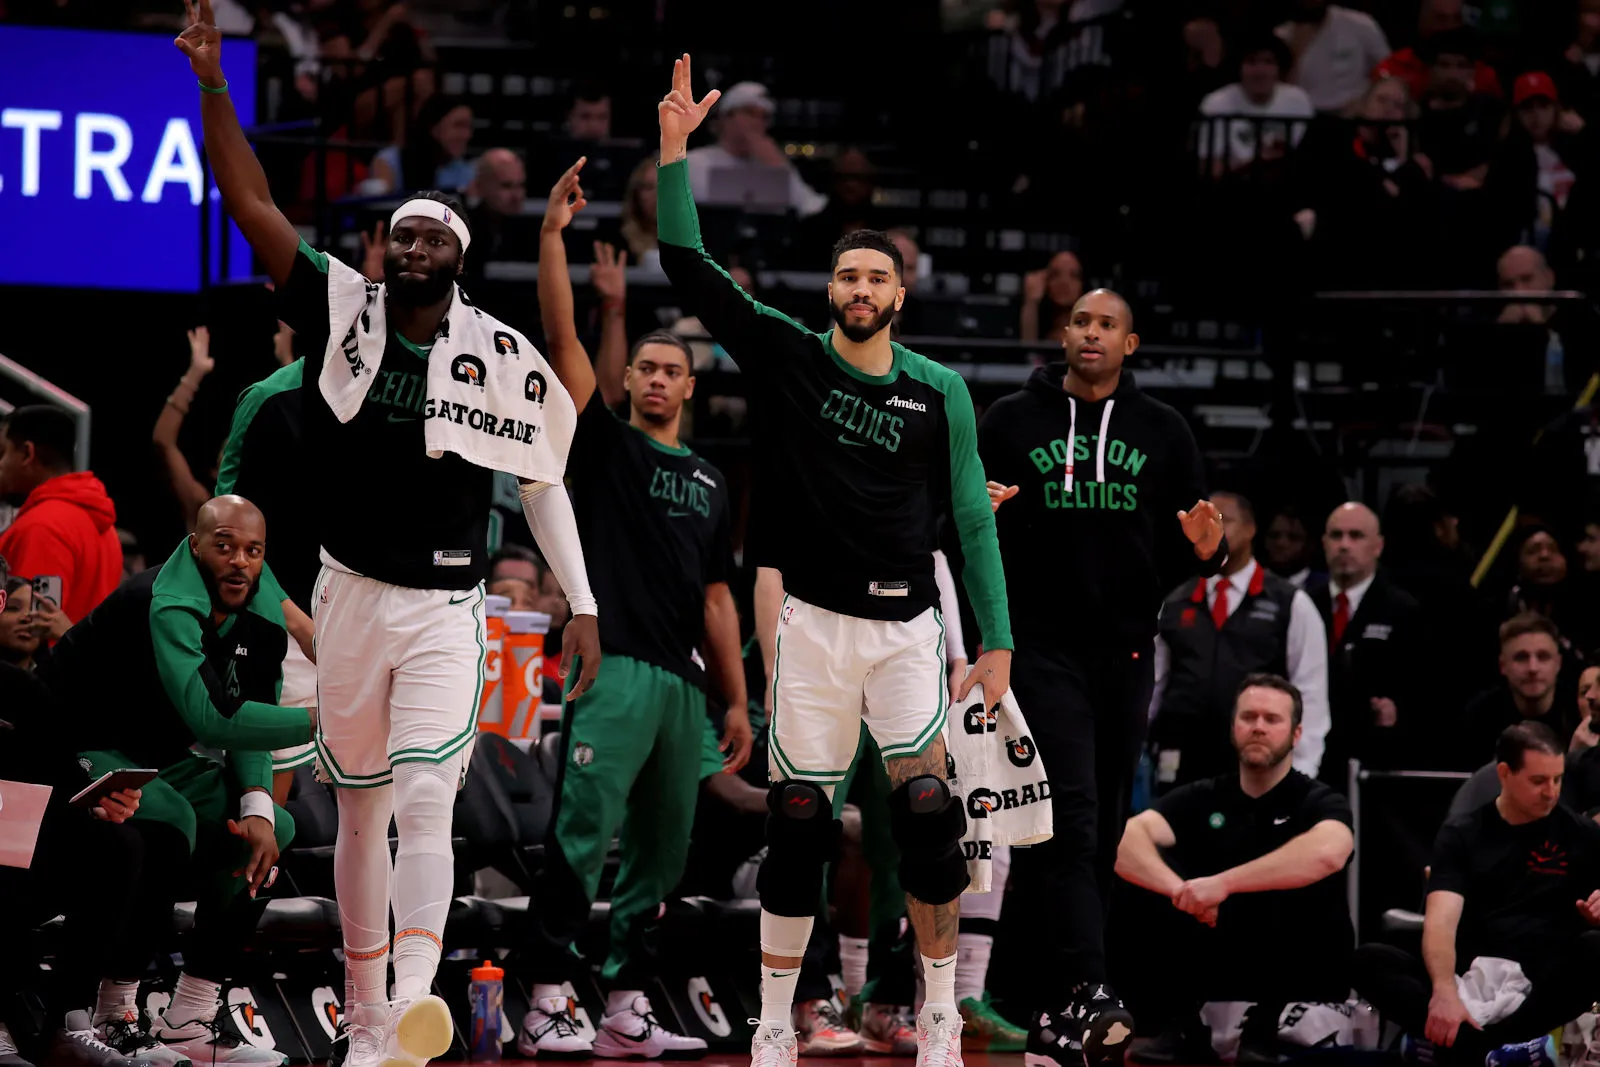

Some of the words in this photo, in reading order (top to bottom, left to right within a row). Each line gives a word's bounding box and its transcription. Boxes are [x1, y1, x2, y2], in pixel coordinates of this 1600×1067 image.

[0, 107, 205, 206] TRA
[424, 398, 536, 446] GATORADE
[819, 389, 905, 453] CELTICS
[886, 395, 926, 413] Amica
[1044, 481, 1138, 511] CELTICS
[524, 655, 544, 699] G
